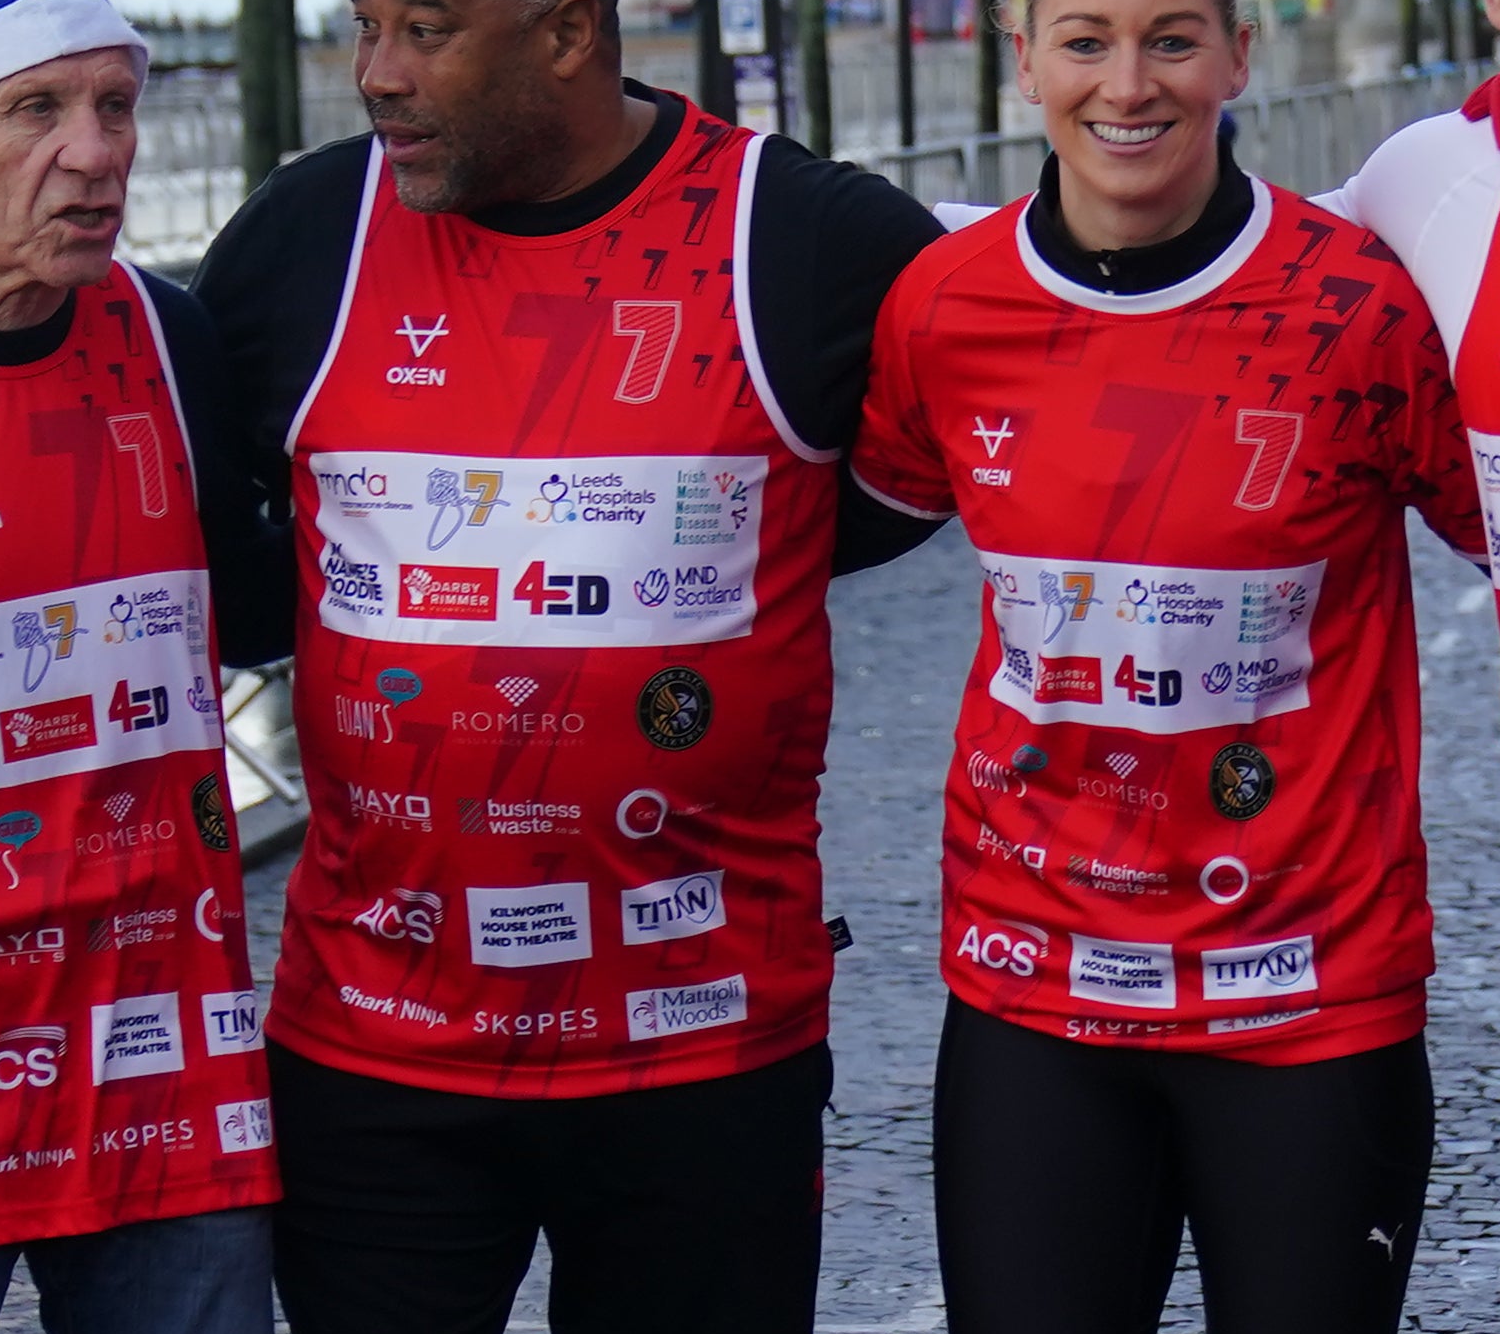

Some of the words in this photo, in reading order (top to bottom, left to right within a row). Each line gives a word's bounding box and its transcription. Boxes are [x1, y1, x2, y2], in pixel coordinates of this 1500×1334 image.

[613, 300, 683, 405] 7
[386, 366, 447, 387] OXEN
[1232, 408, 1304, 512] 7
[571, 472, 624, 488] Leeds
[677, 469, 708, 484] Irish
[577, 488, 657, 506] Hospitals
[676, 485, 711, 499] Motor
[582, 506, 647, 525] Charity
[674, 516, 719, 531] Disease
[675, 565, 719, 586] MND
[133, 587, 170, 607] Leeds
[430, 580, 482, 594] DARBY
[673, 584, 743, 608] Scotland
[1150, 579, 1197, 597] Leeds
[430, 594, 490, 607] RIMMER
[1156, 595, 1225, 613] Hospitals
[1160, 611, 1217, 627] Charity
[1236, 657, 1280, 677] MND
[1235, 667, 1303, 695] Scotland
[34, 712, 80, 731] DARBY
[451, 711, 586, 734] ROMERO
[34, 722, 88, 742] RIMMER
[348, 782, 432, 819] MAYO
[1076, 775, 1170, 813] ROMERO
[487, 798, 582, 818] business
[488, 818, 554, 835] waste
[74, 819, 176, 857] ROMERO
[1090, 857, 1170, 884] business
[1091, 875, 1146, 897] waste
[489, 901, 565, 919] KILWORTH
[629, 886, 709, 926] TITAN
[352, 897, 437, 945] ACS
[480, 919, 529, 934] HOUSE
[531, 915, 578, 931] HOTEL
[481, 933, 513, 948] AND
[515, 928, 578, 947] THEATRE
[955, 925, 1038, 978] ACS
[1209, 951, 1298, 982] TITAN
[661, 980, 741, 1007] Mattioli
[339, 984, 397, 1016] Shark
[401, 998, 449, 1031] NINJA
[662, 1003, 731, 1029] Woods
[472, 1007, 599, 1037] SKOPES
